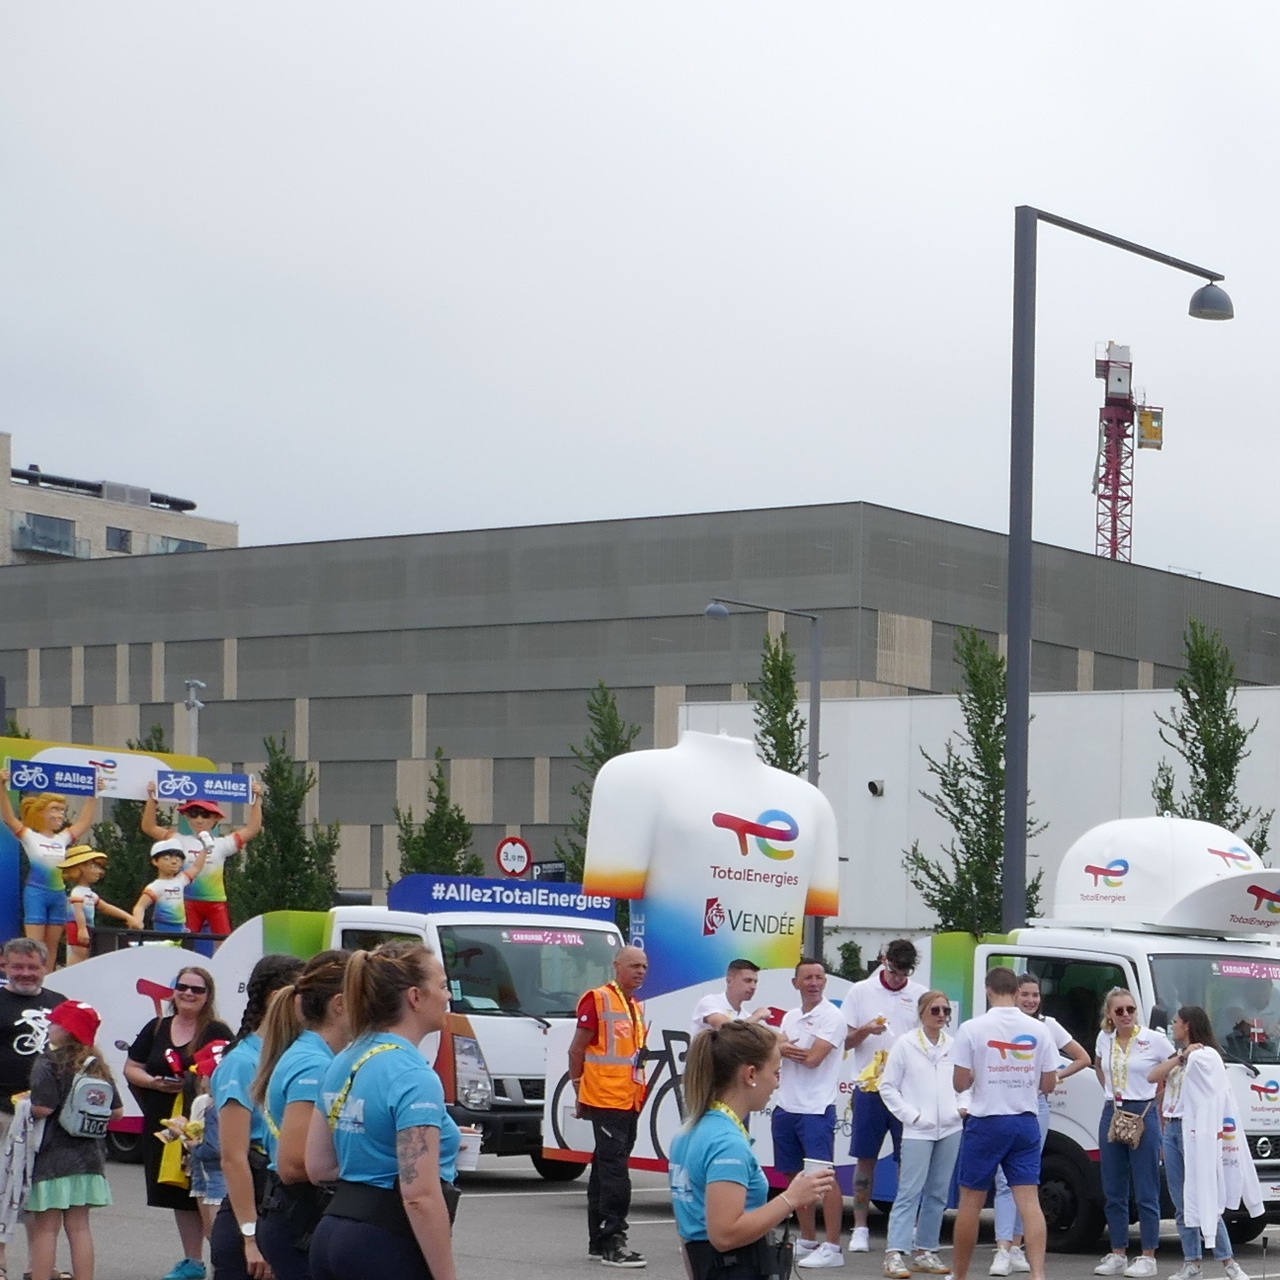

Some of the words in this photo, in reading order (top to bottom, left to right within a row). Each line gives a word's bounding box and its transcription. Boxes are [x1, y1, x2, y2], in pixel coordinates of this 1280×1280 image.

[54, 771, 94, 785] #Allez
[203, 779, 247, 792] #Allez
[533, 865, 541, 880] P
[710, 865, 799, 888] TotalEnergies
[431, 882, 611, 911] #AllezTotalEnergies
[1079, 893, 1126, 904] TotalEnergies
[728, 909, 796, 936] VENDÉE
